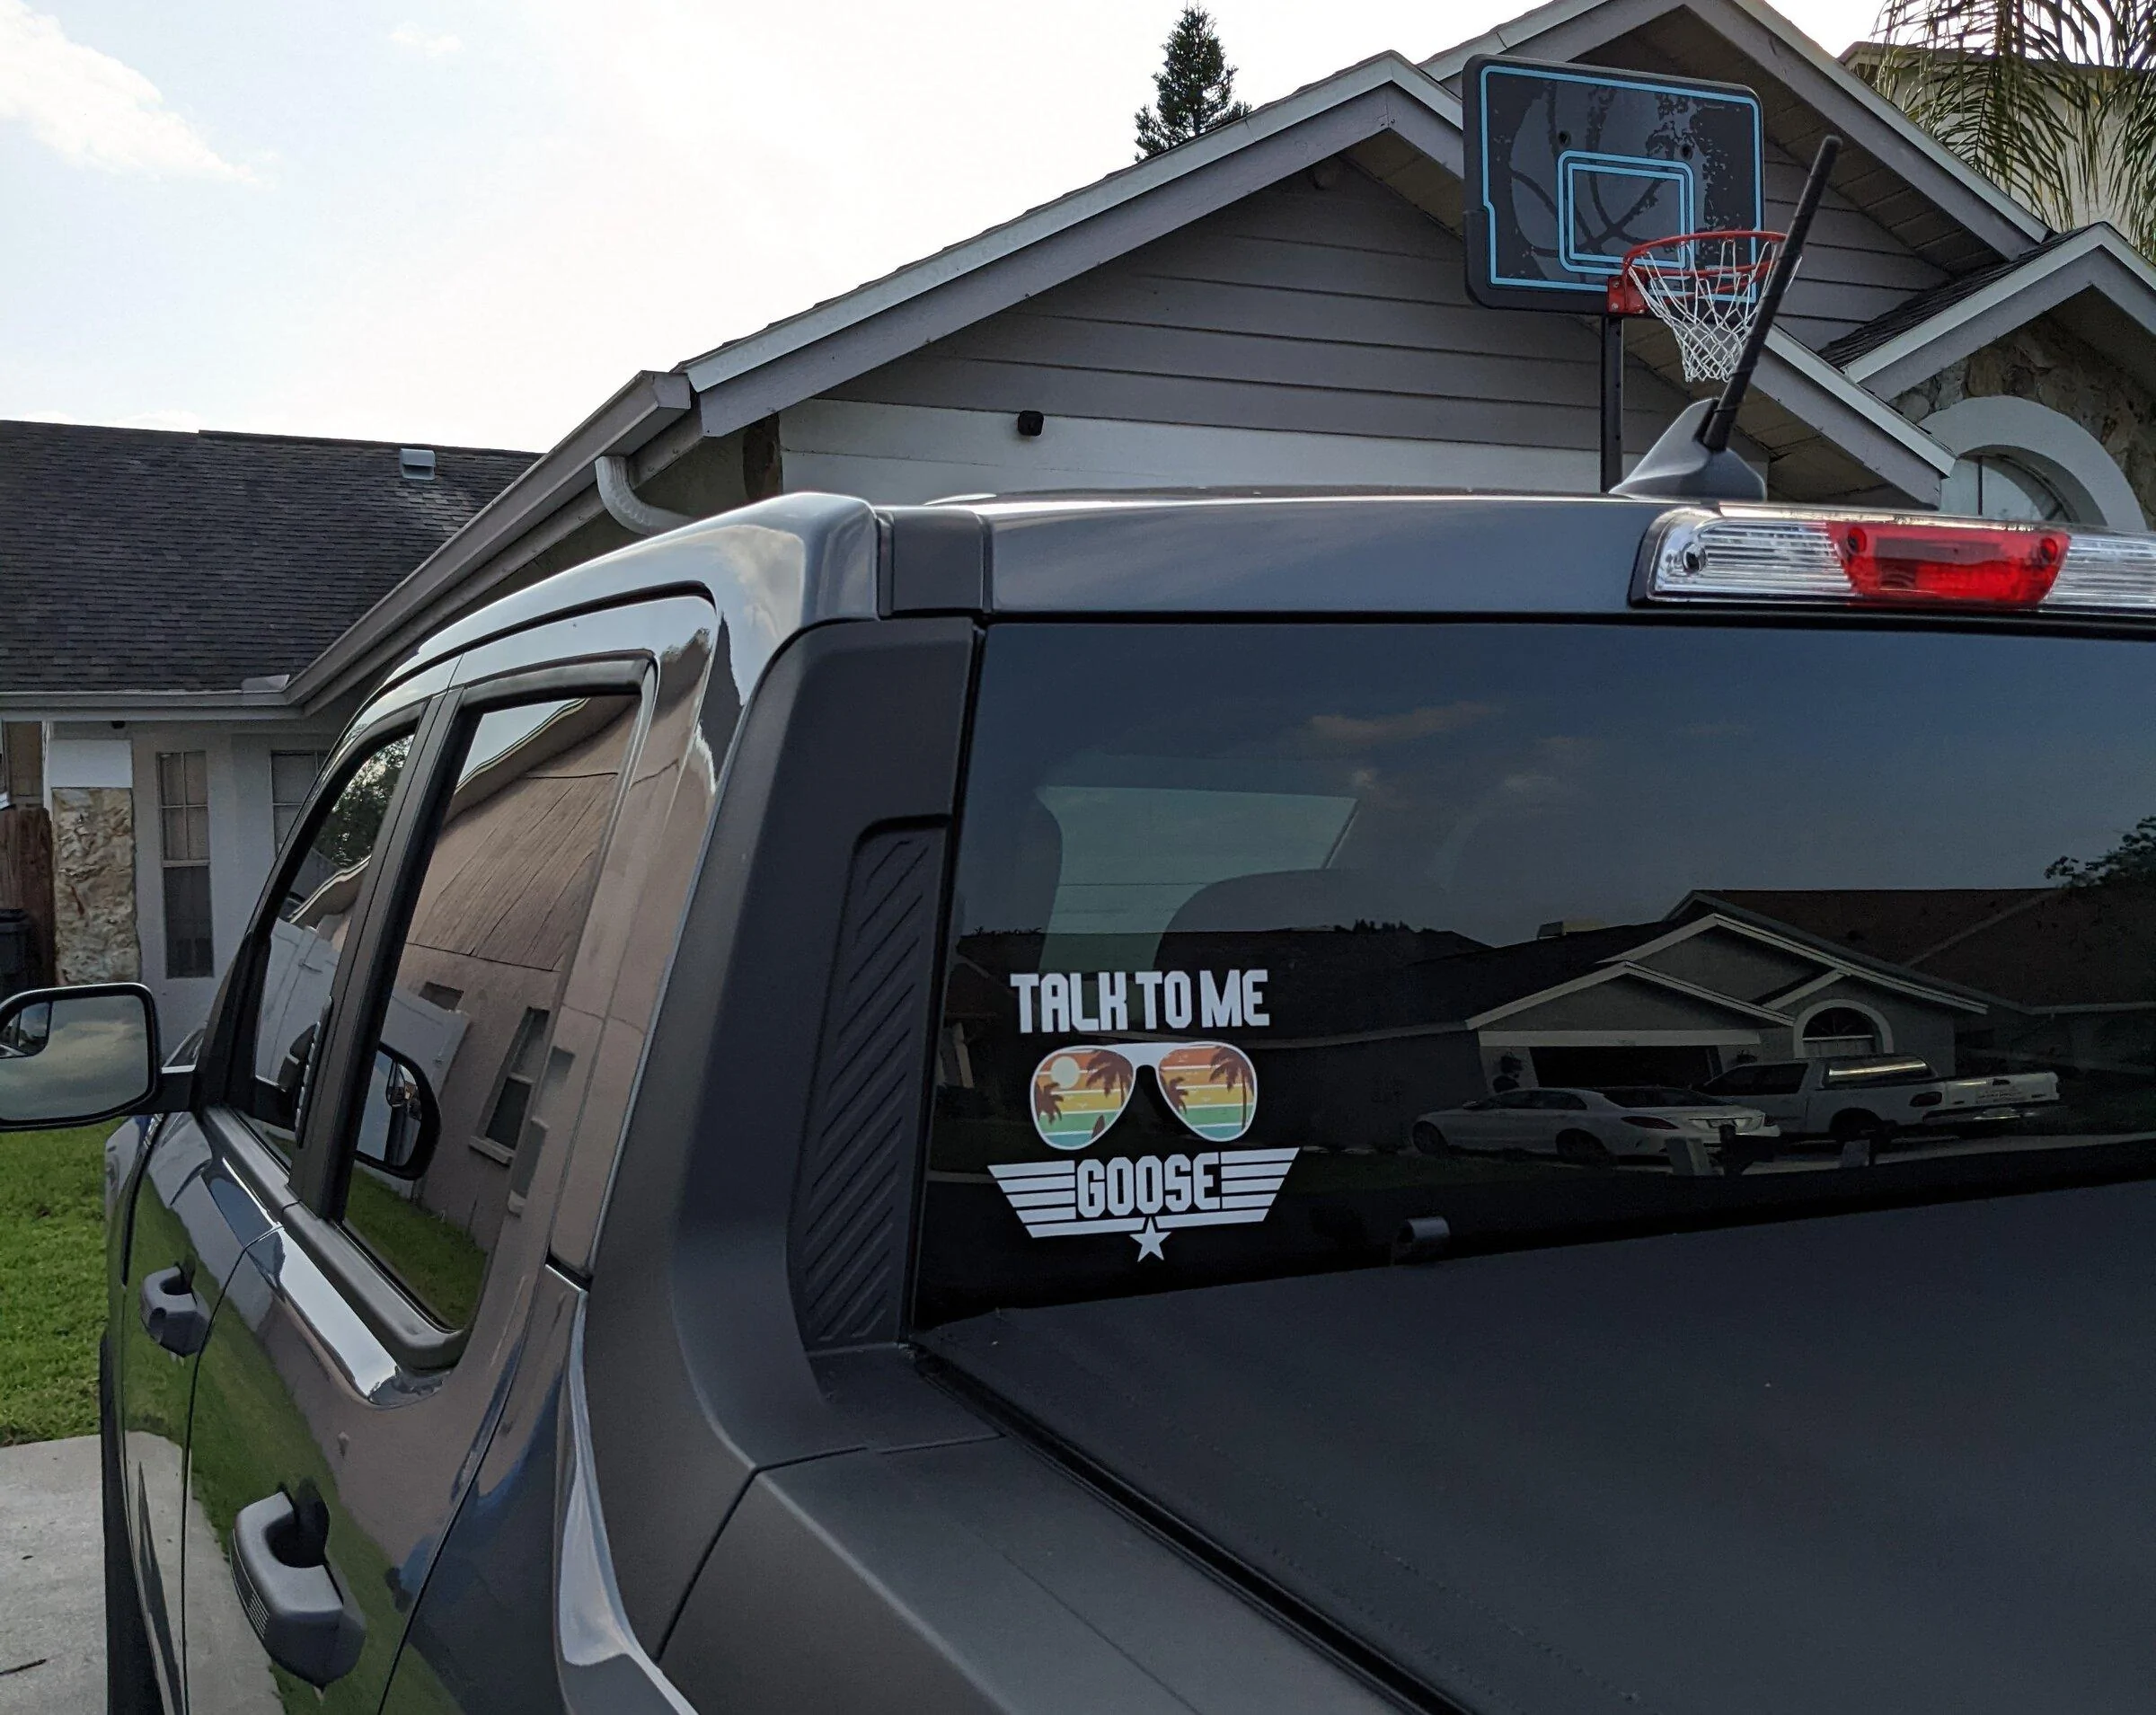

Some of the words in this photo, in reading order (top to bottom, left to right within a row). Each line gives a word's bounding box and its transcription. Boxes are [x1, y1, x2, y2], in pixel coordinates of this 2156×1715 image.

[1010, 972, 1128, 1033] TALK
[1135, 970, 1192, 1030] TO
[1199, 969, 1270, 1028] ME
[1077, 1152, 1221, 1218] GOOSE
